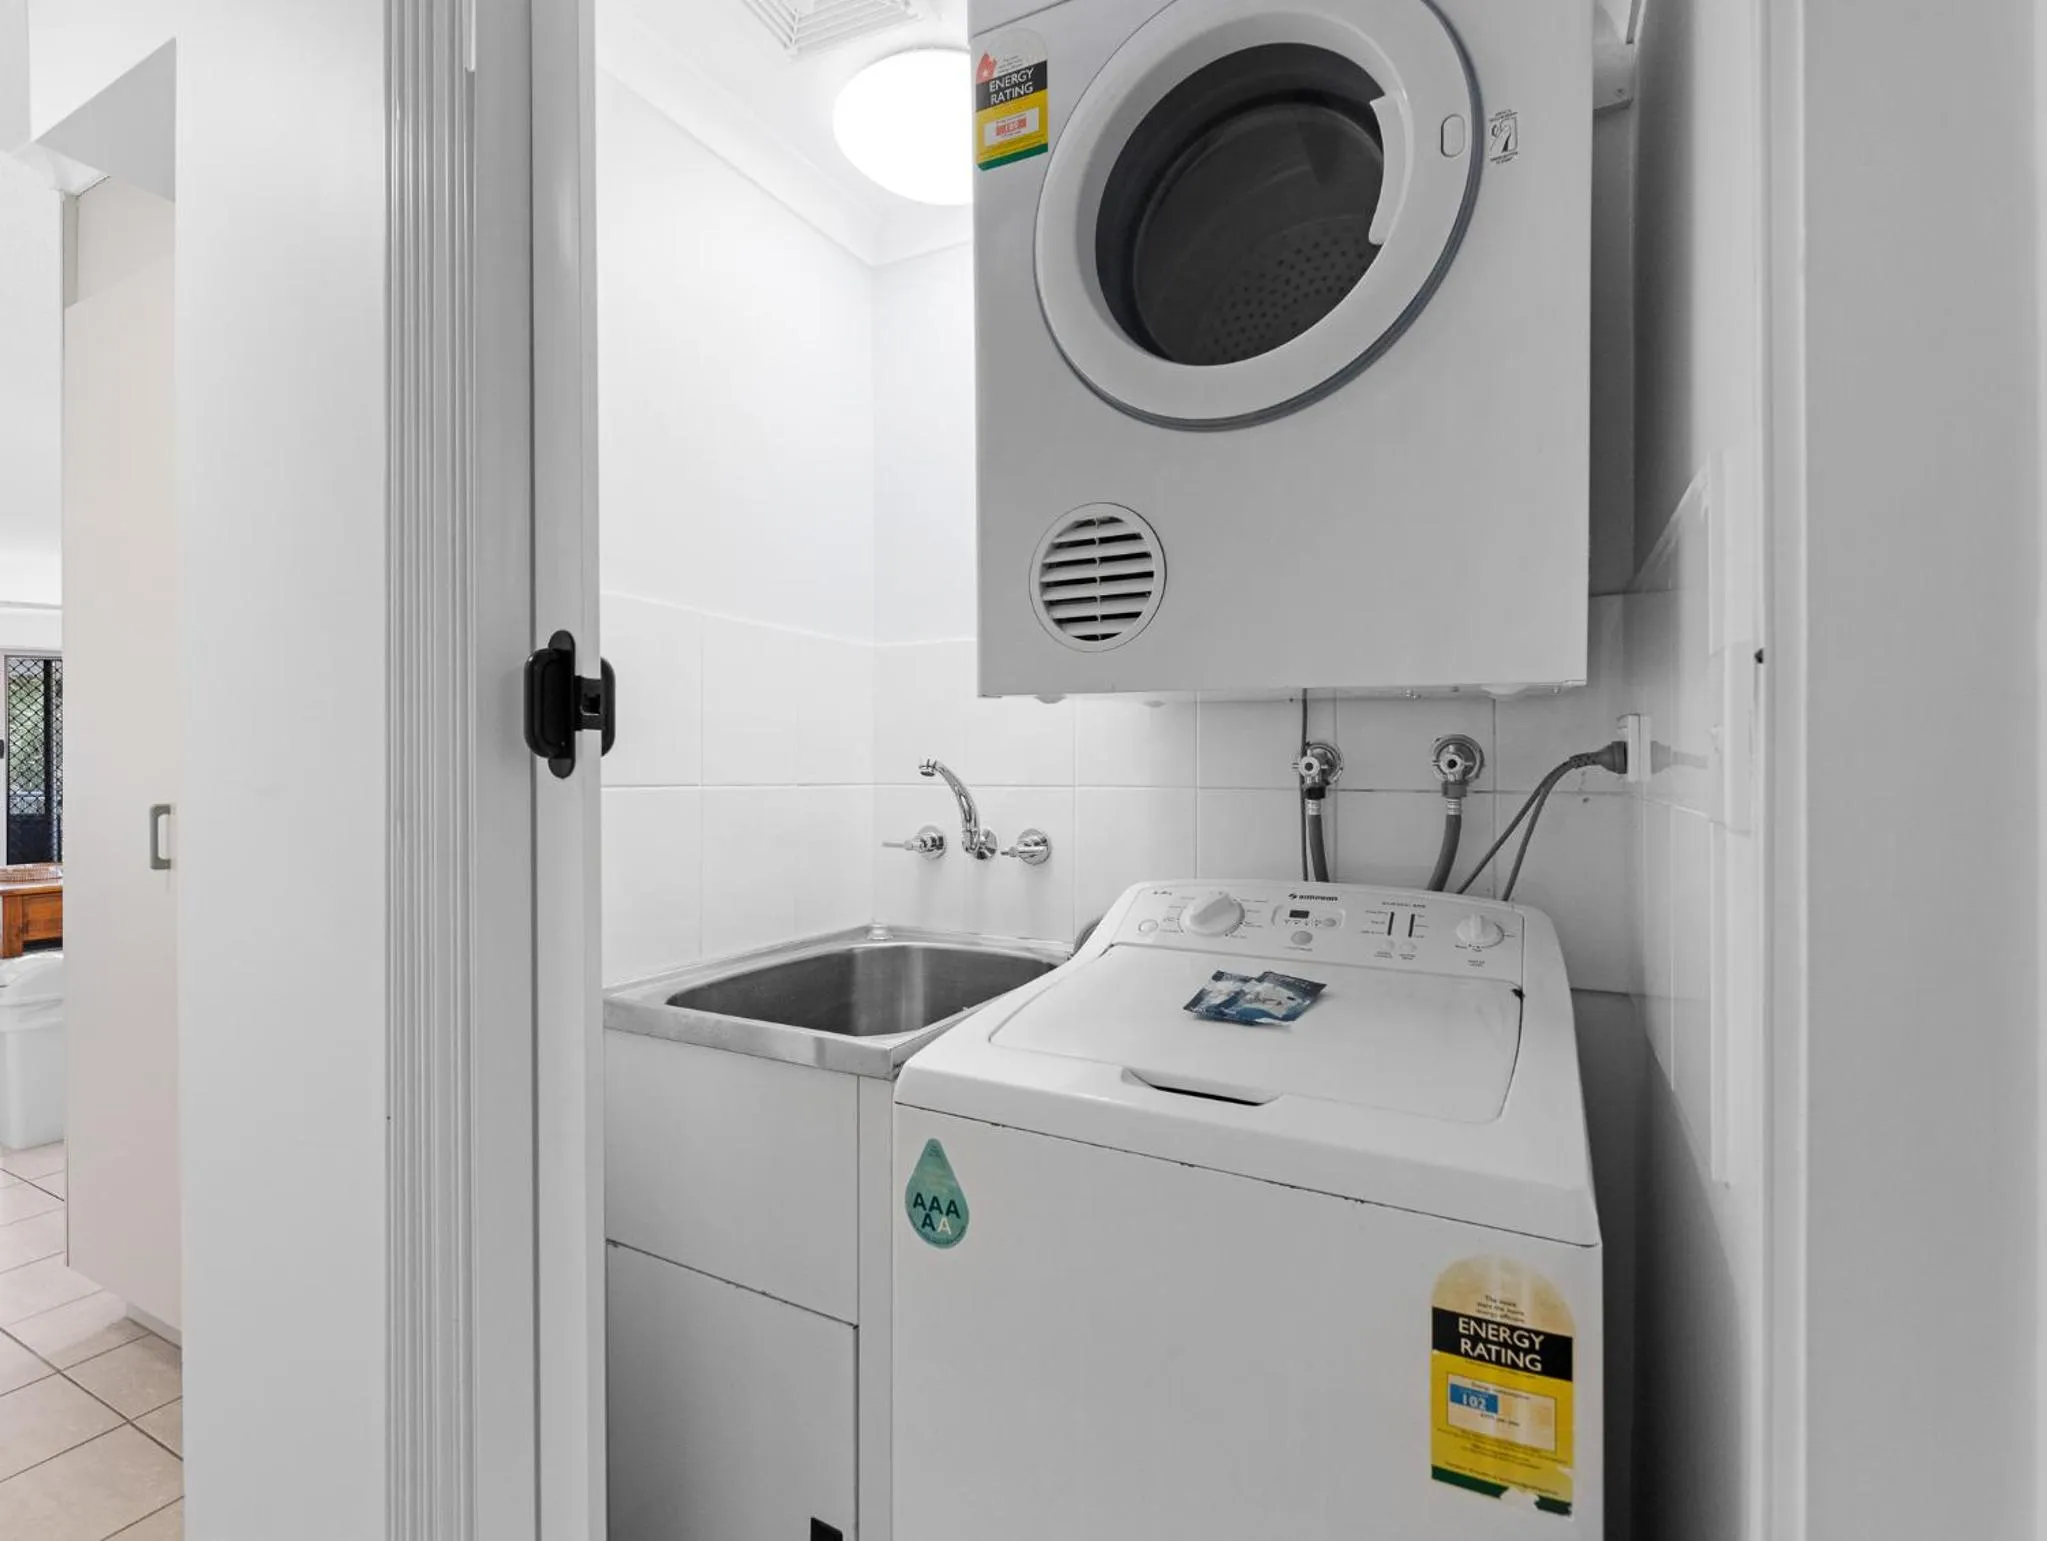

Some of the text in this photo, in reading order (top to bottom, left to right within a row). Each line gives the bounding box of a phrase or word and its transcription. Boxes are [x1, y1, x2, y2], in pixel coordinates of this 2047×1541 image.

[989, 68, 1034, 92] ENERGY
[990, 82, 1033, 105] RATING
[1458, 1317, 1545, 1350] ENERGY
[1460, 1338, 1542, 1371] RATING
